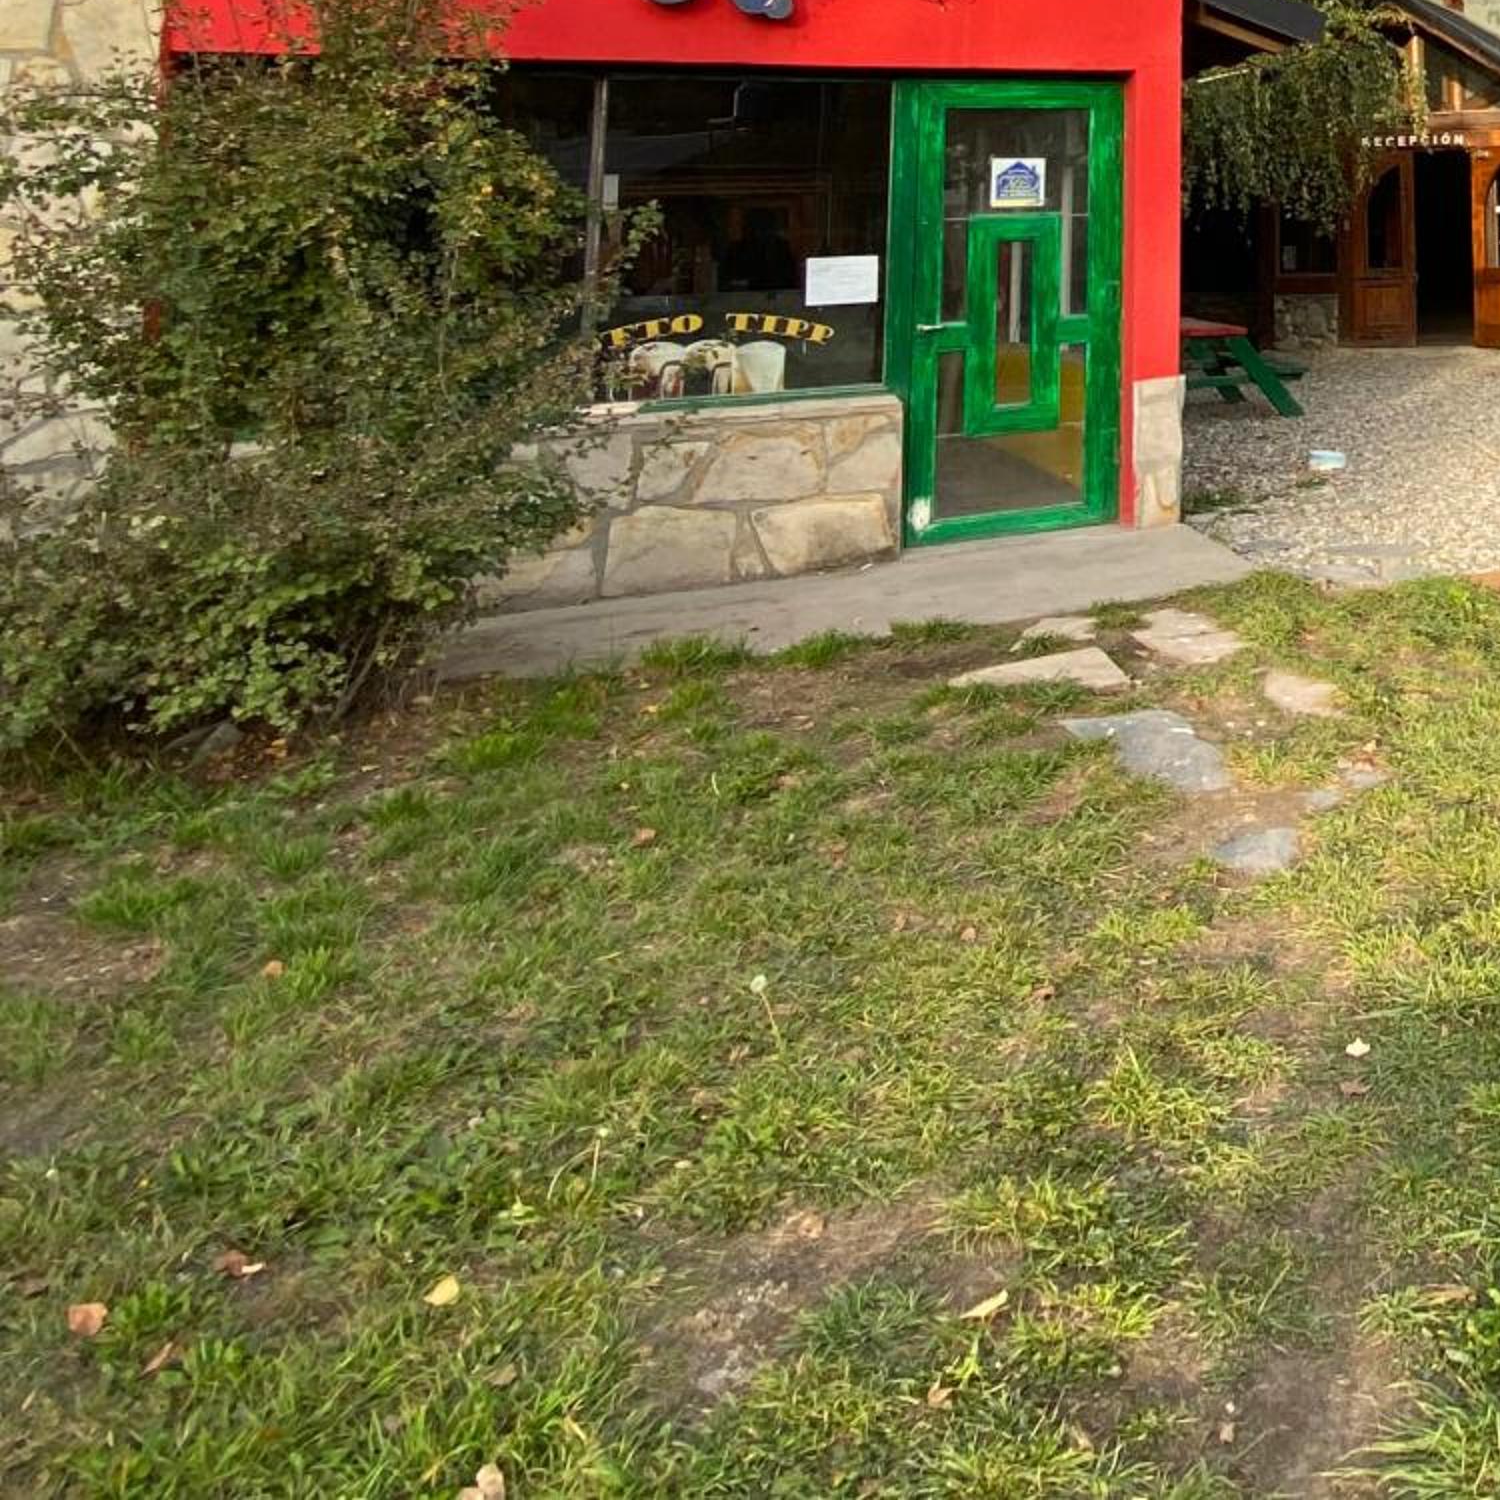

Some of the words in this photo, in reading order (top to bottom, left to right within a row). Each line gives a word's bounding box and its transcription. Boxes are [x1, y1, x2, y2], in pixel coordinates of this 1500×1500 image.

[1361, 132, 1464, 147] RECEPCIÓN
[600, 313, 704, 347] TTO
[725, 312, 836, 345] TIPP
